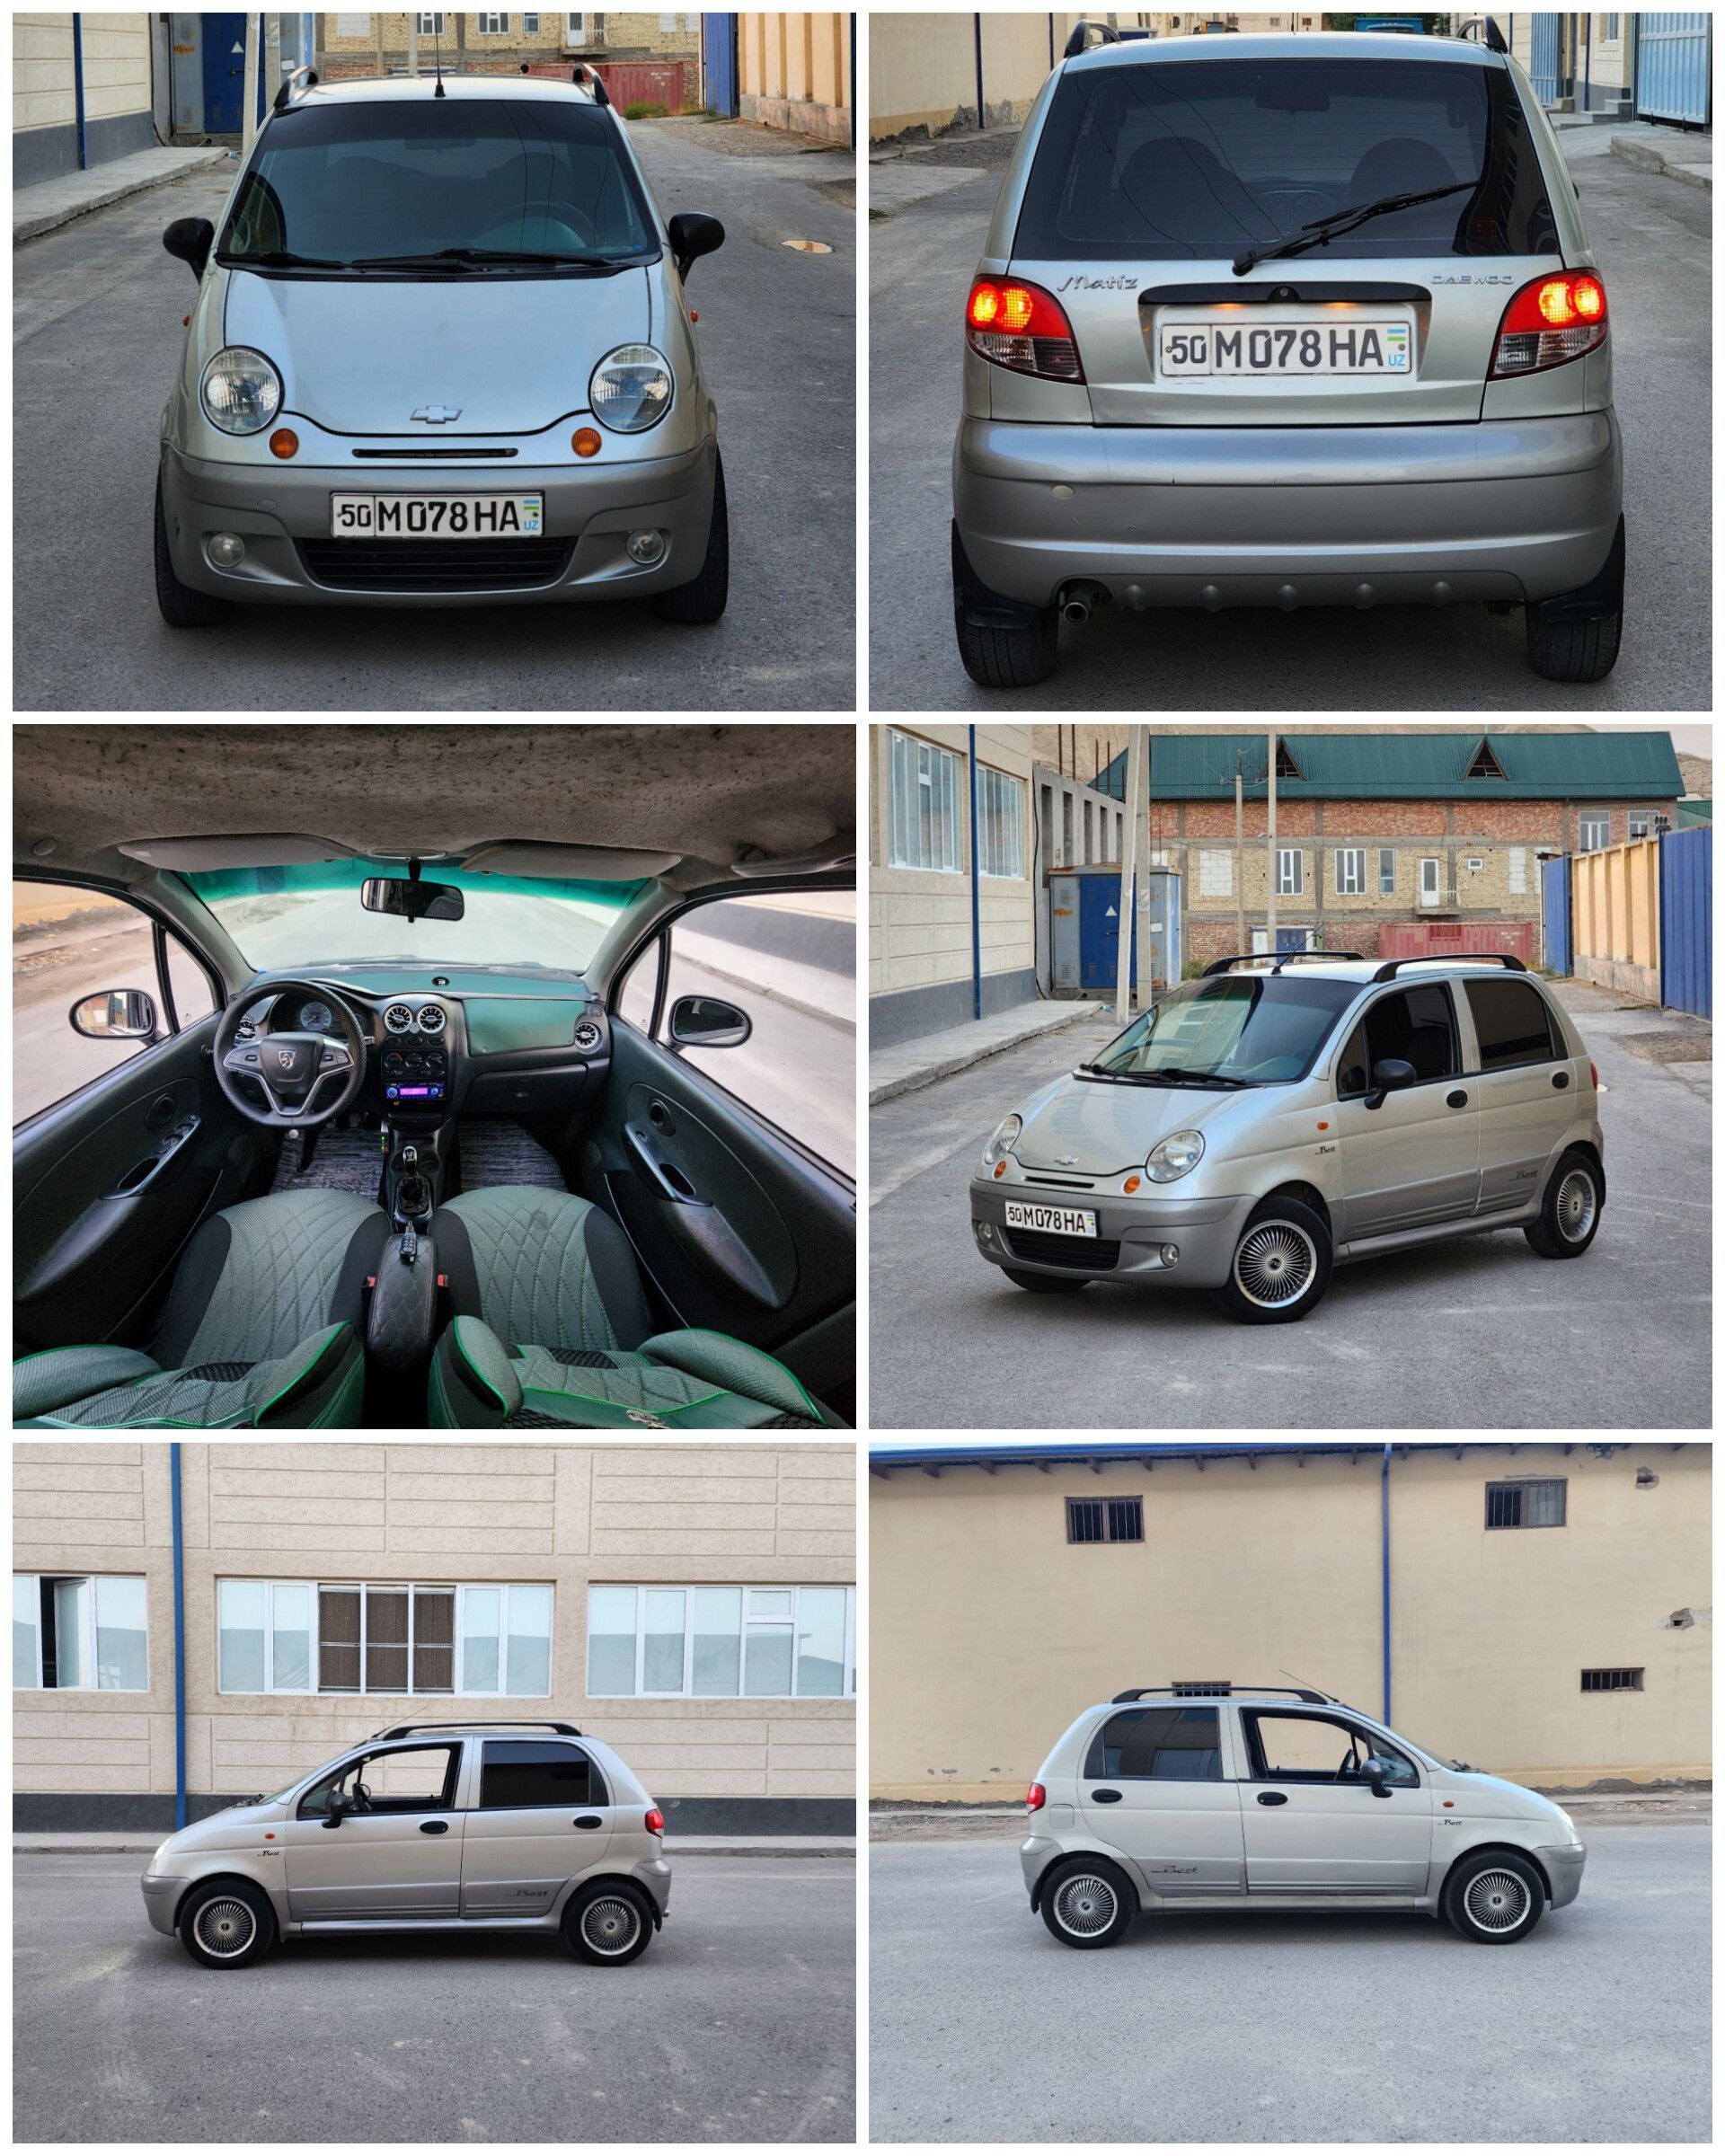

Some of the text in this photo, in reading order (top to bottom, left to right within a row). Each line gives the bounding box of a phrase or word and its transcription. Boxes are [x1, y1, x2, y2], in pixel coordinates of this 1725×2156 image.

[1057, 273, 1138, 292] Matiz
[1431, 275, 1515, 285] DAEWOO
[1172, 335, 1207, 364] 50
[1387, 355, 1406, 367] UZ
[341, 504, 372, 527] 50
[524, 521, 539, 531] UZ
[1008, 1206, 1022, 1223] 50
